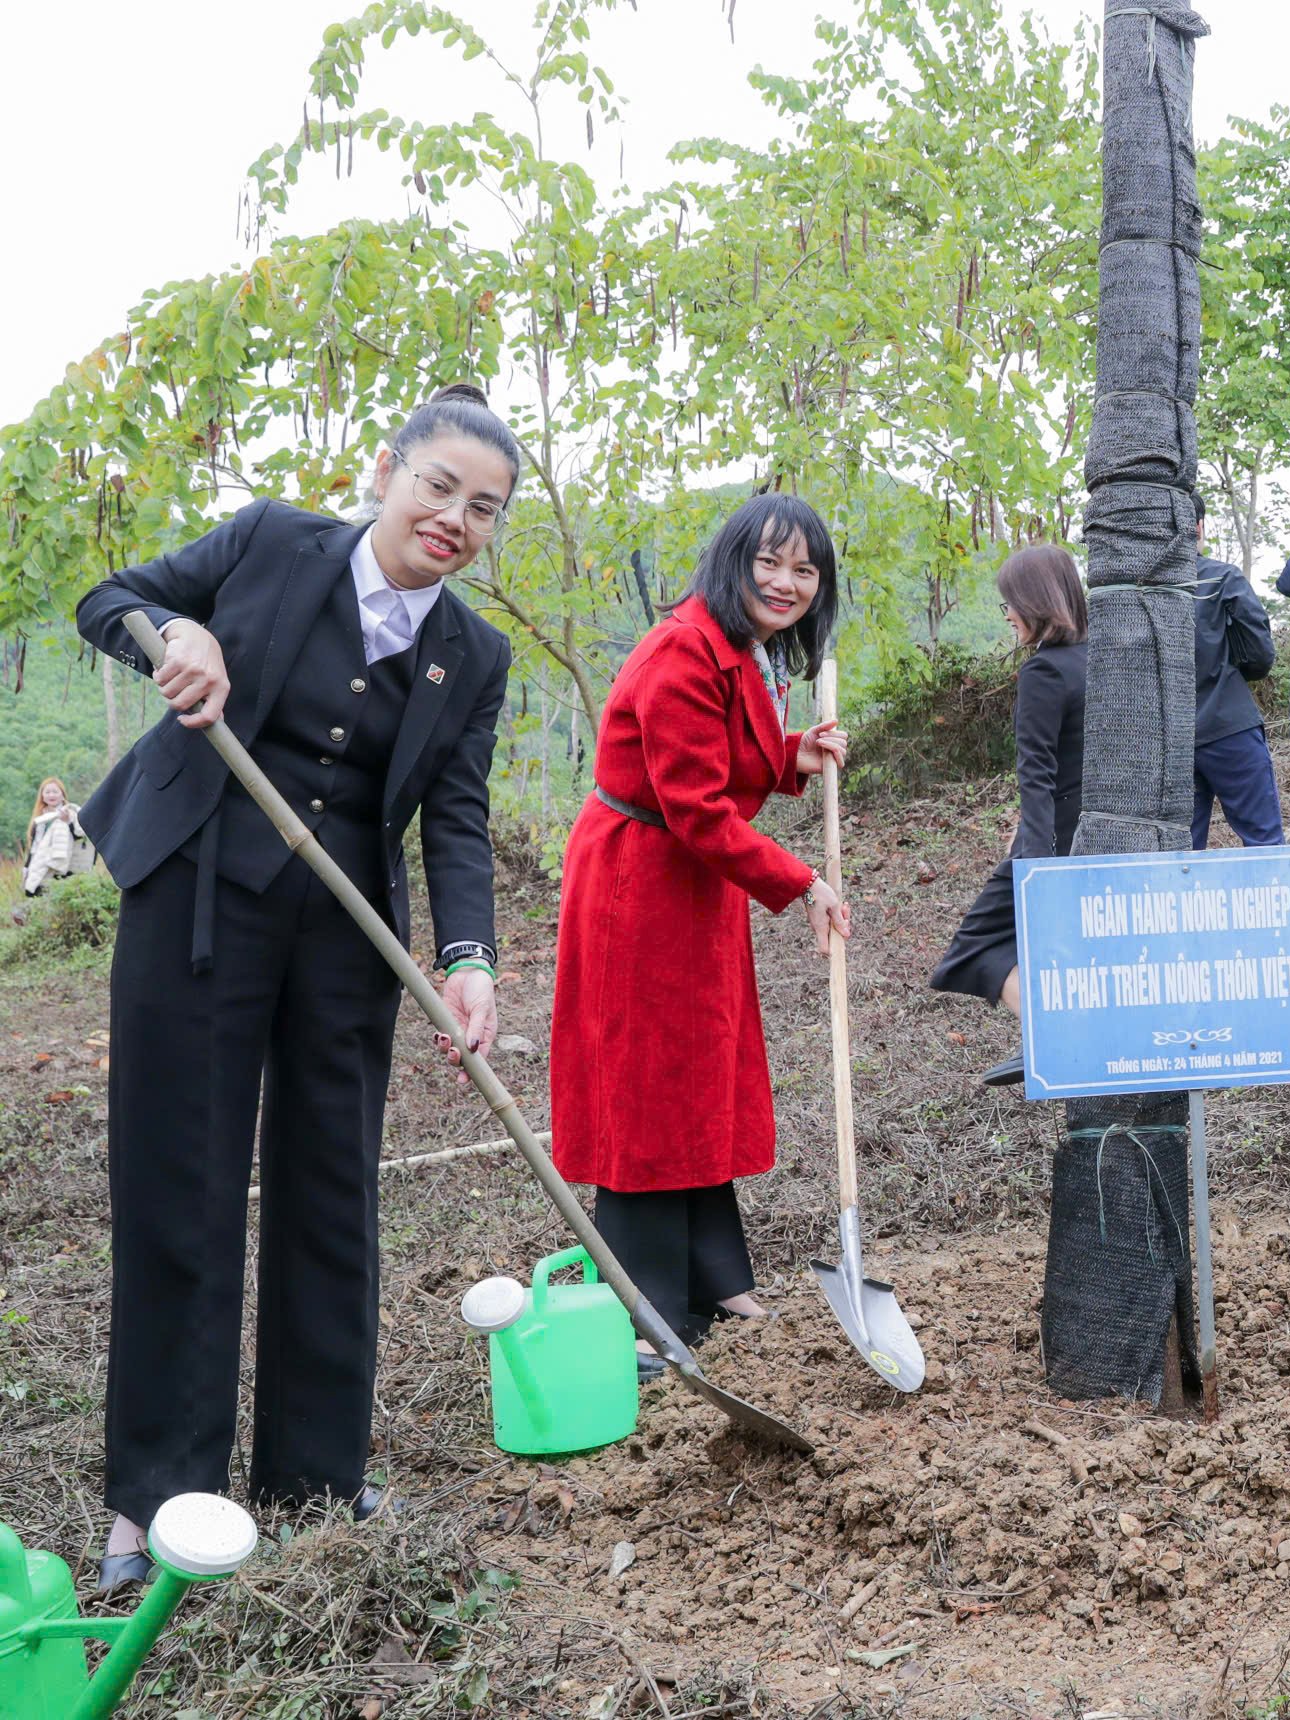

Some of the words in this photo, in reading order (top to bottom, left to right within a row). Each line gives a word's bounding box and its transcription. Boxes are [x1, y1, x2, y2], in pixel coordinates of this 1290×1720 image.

[1080, 885, 1128, 938] NGÂN
[1131, 883, 1178, 935] HÀNG
[1181, 880, 1229, 933] NÔNG
[1040, 959, 1063, 1011] VÀ
[1066, 957, 1108, 1010] PHÁT
[1111, 945, 1161, 1007] TRIỂN
[1164, 952, 1212, 1004] NÔNG
[1214, 949, 1258, 1001] THÔN
[1141, 1056, 1172, 1072] NGÀY:
[1174, 1056, 1187, 1070] 24
[1188, 1052, 1222, 1069] THÁNG
[1224, 1054, 1231, 1067] 4
[1232, 1051, 1257, 1066] NĂM
[1258, 1051, 1283, 1065] 2021
